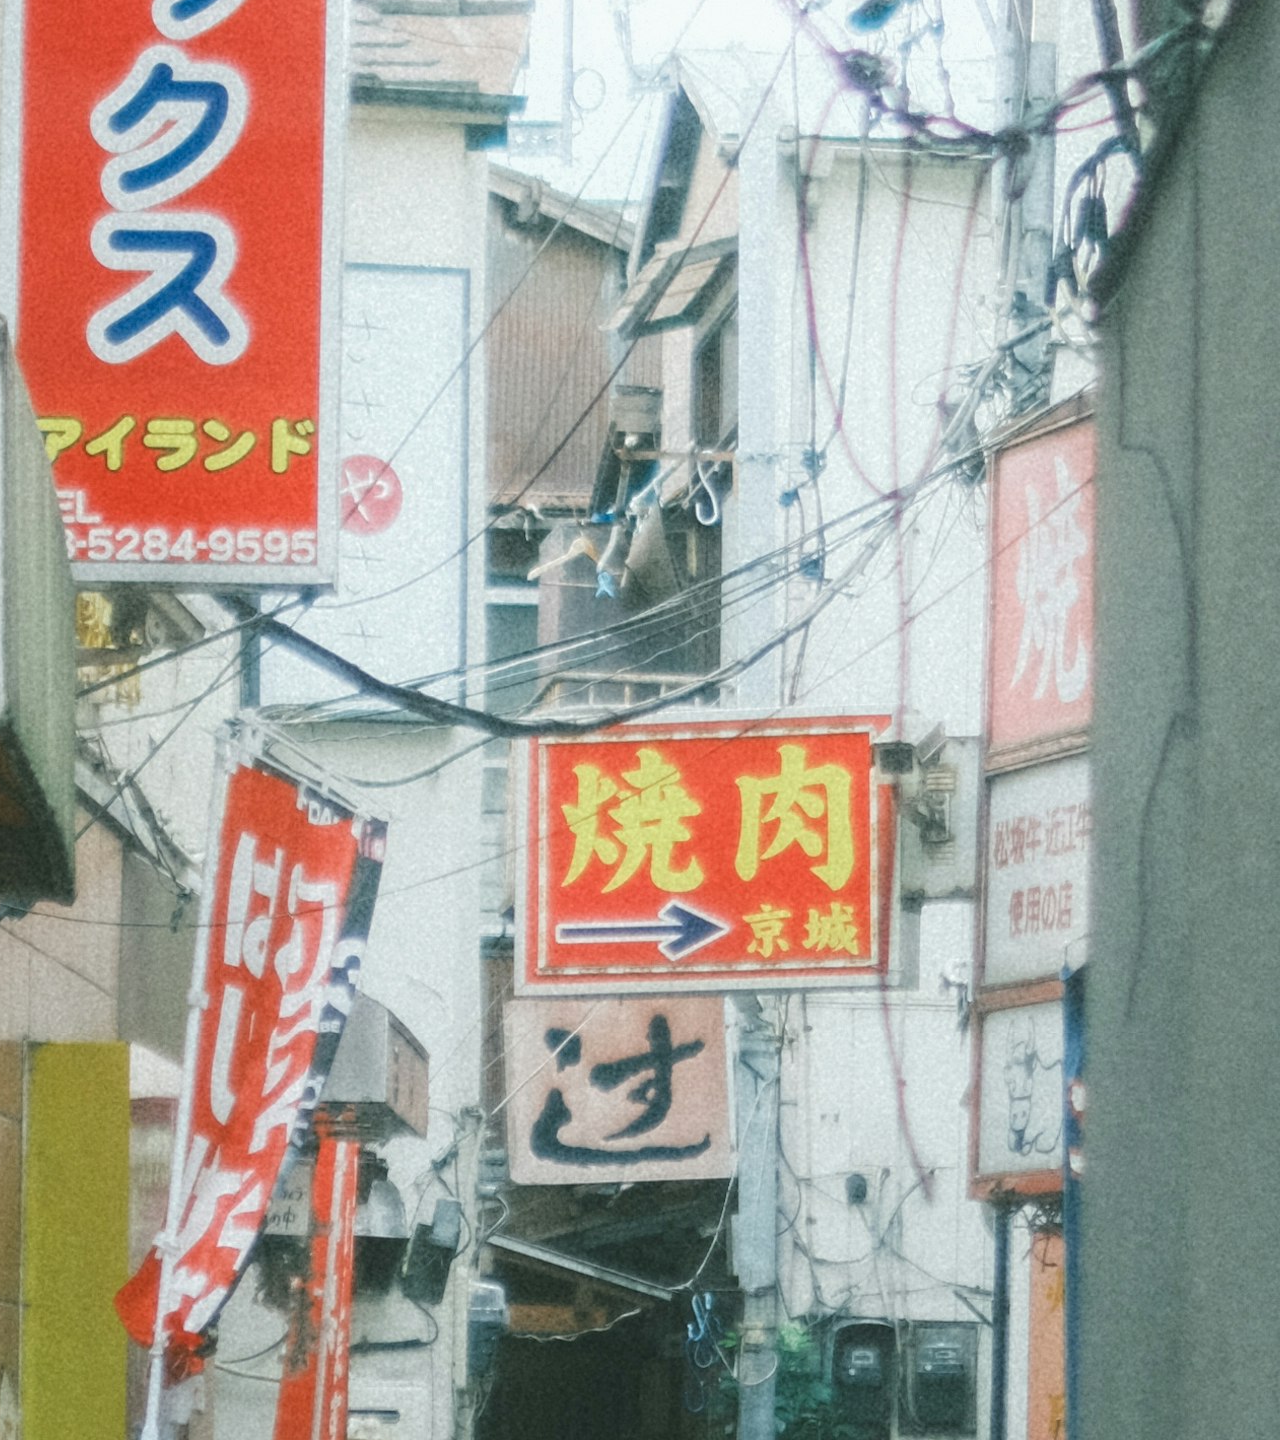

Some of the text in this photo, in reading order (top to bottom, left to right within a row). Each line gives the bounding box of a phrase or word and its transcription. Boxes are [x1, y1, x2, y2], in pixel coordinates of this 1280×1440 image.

[37, 415, 317, 474] アイランド
[561, 746, 856, 894] 焼肉
[741, 901, 860, 958] 京城
[1008, 880, 1073, 939] 使用の店
